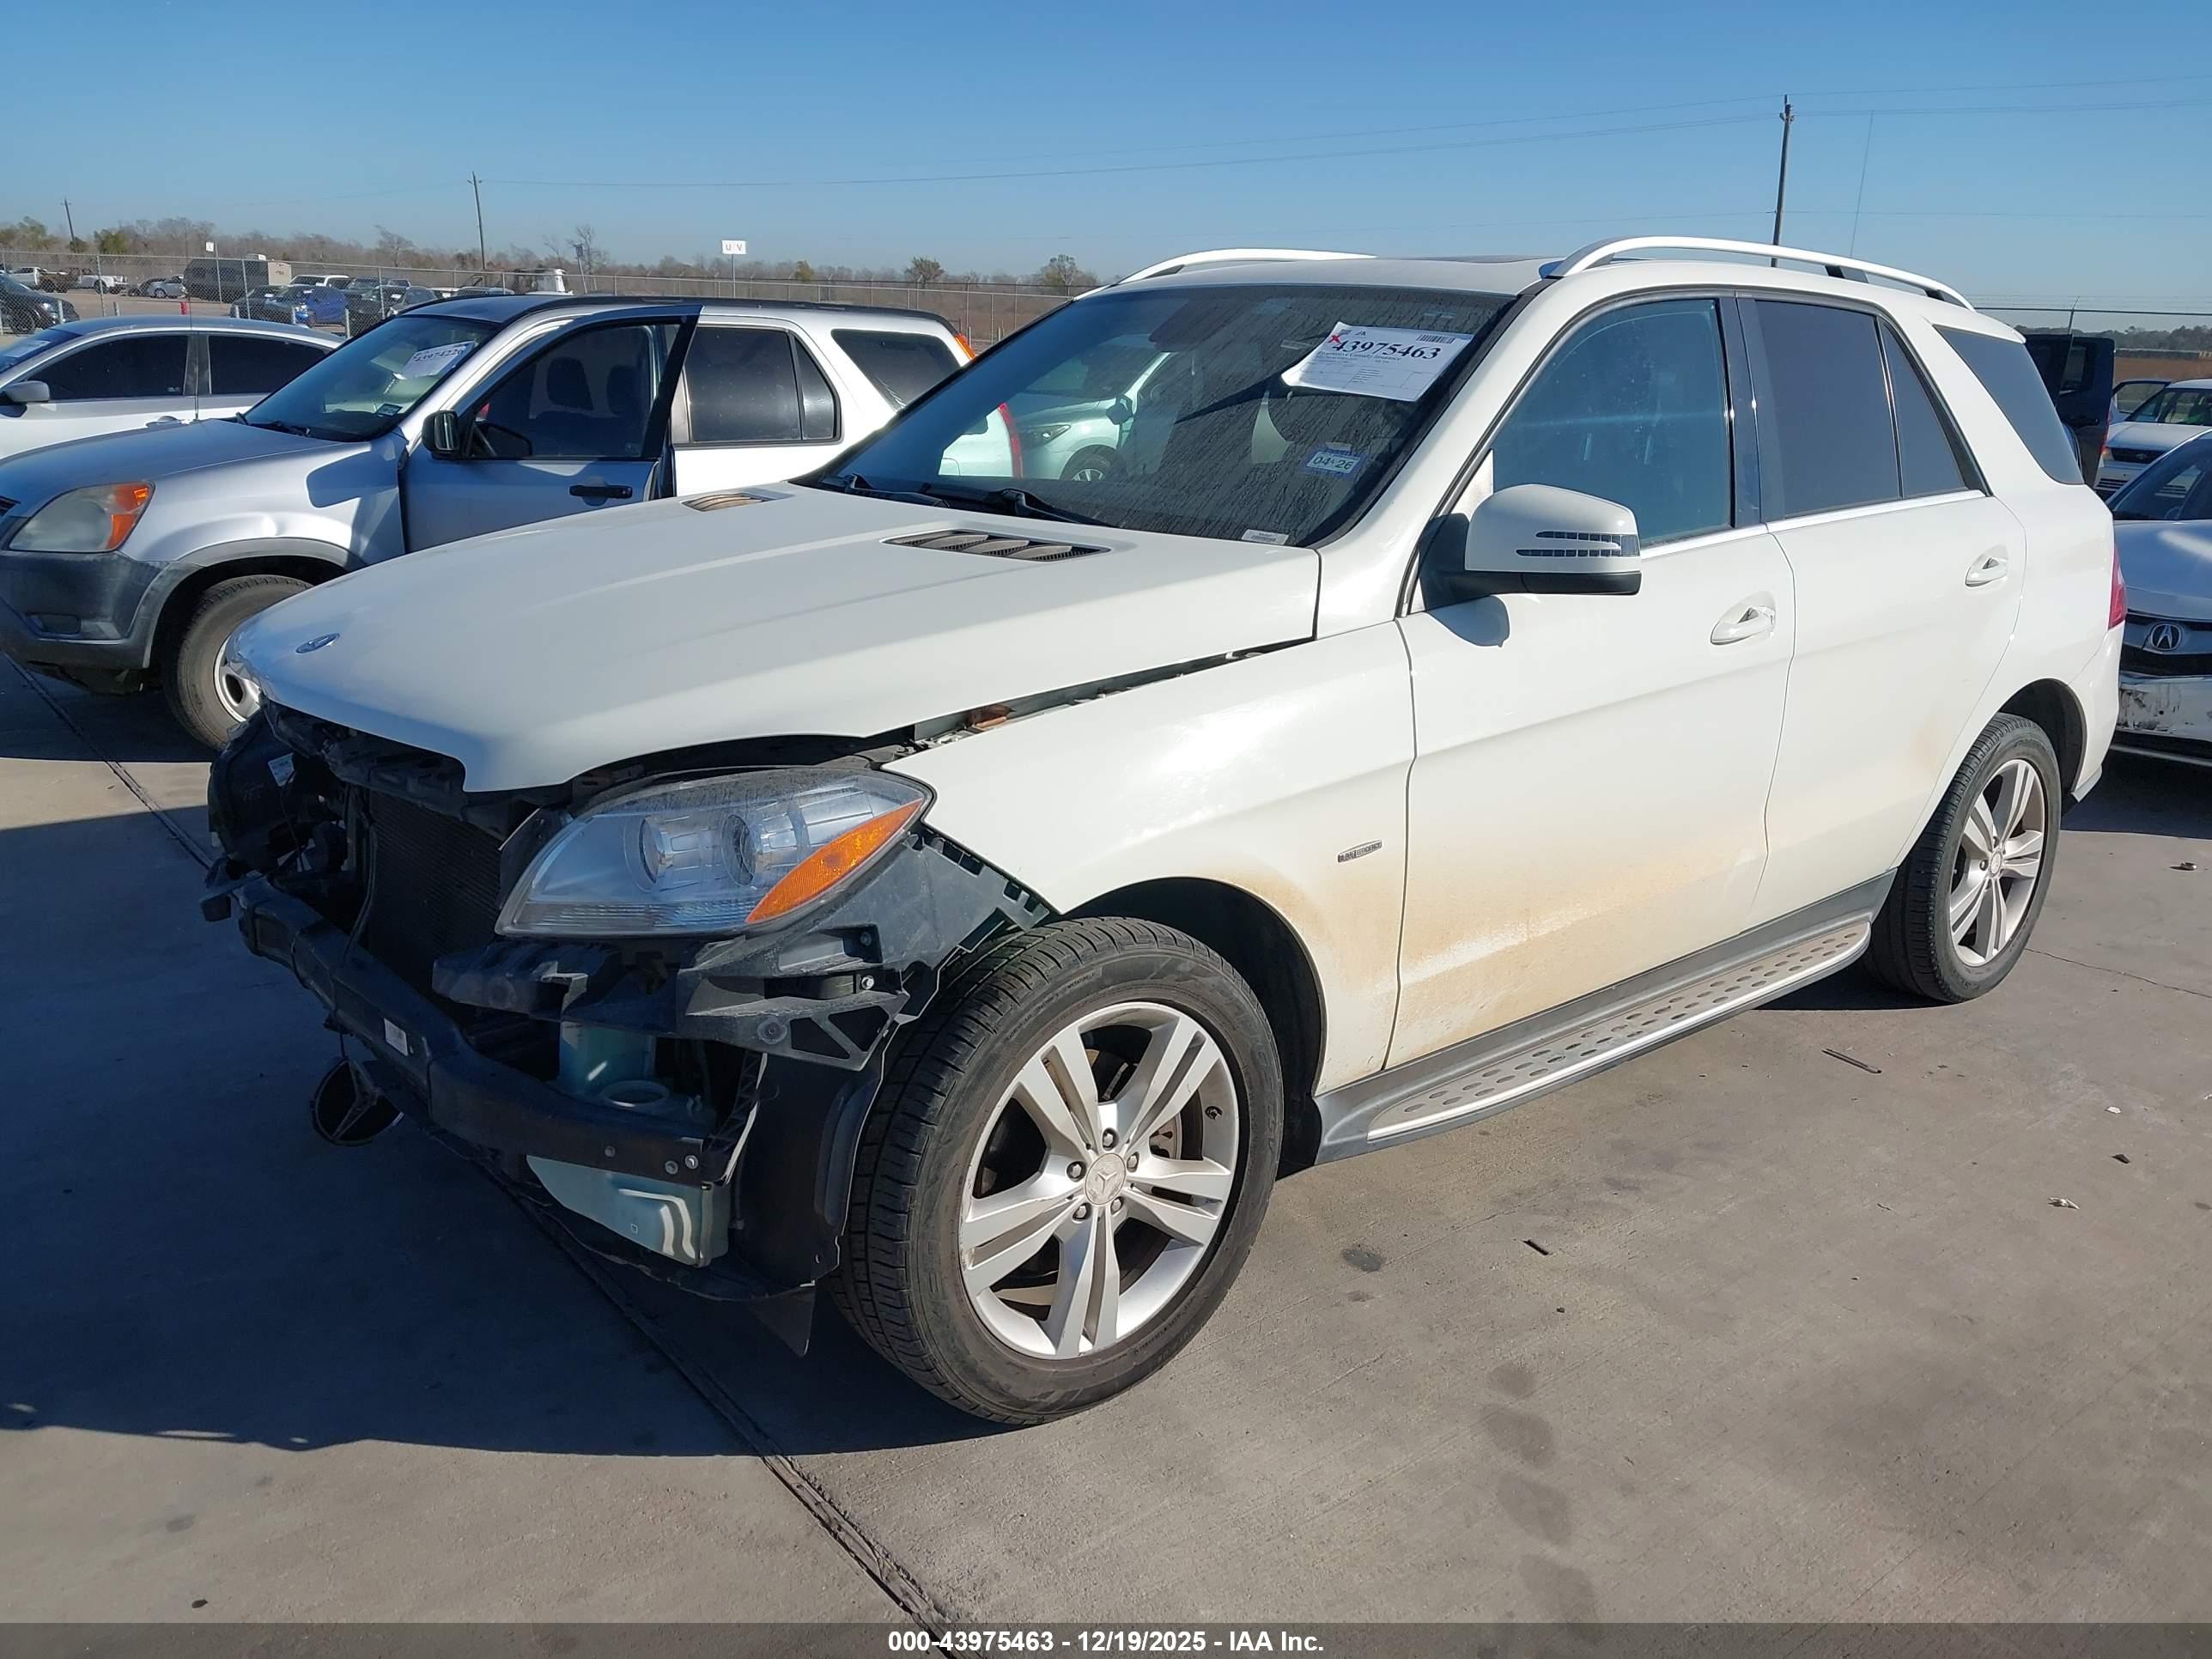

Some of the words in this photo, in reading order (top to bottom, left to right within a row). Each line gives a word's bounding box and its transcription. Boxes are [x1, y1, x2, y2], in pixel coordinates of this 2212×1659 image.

[1332, 340, 1442, 360] 43975463
[1313, 456, 1332, 465] 04
[1334, 459, 1354, 470] 26
